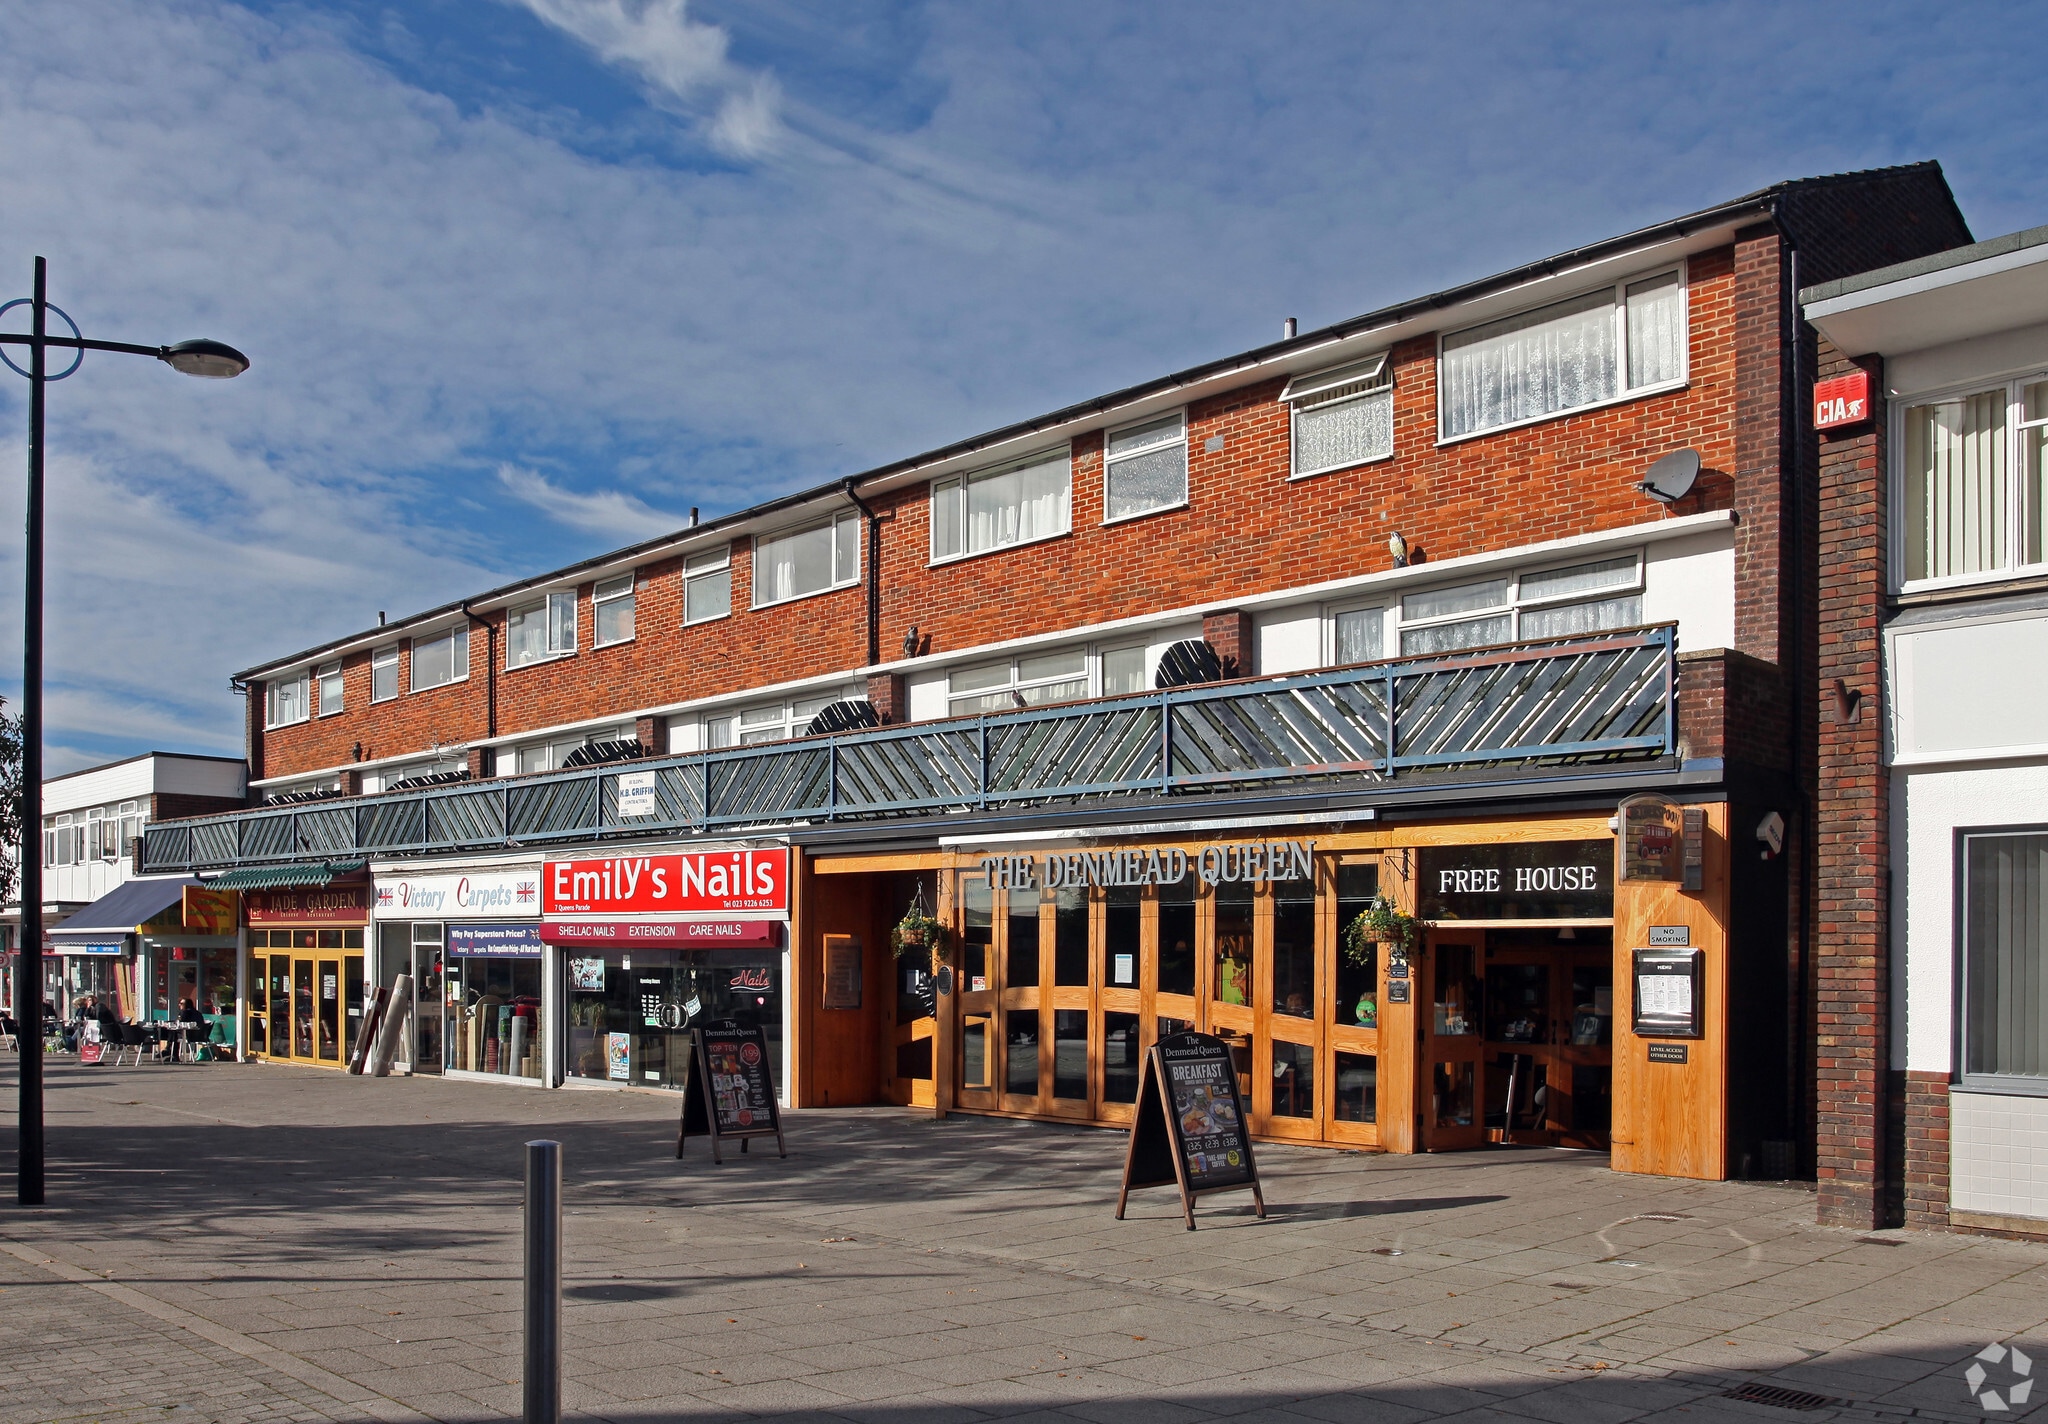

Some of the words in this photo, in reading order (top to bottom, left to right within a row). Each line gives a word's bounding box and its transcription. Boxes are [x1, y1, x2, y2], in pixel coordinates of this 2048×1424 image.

[1816, 397, 1847, 425] CIA
[631, 786, 654, 796] GRIFFIN
[980, 855, 1036, 890] THE
[1043, 847, 1187, 889] DENMEAD
[1197, 840, 1318, 887] QUEEN
[554, 858, 668, 901] Emily's
[681, 852, 775, 897] Nails
[1439, 868, 1500, 893] FREE
[1515, 866, 1597, 891] HOUSE
[398, 882, 446, 911] Victory
[457, 877, 512, 912] Carpets
[271, 895, 298, 913] JADE
[306, 891, 356, 913] GARDEN
[558, 904, 575, 912] Queens
[743, 899, 758, 907] 9226
[759, 899, 773, 907] 6253
[451, 930, 463, 939] Why
[463, 930, 474, 939] Pay
[474, 930, 505, 939] Superstore
[505, 930, 527, 938] Prices?
[558, 925, 592, 936] SHELLAC
[593, 925, 615, 937] NAILS
[629, 925, 675, 937] EXTENSION
[689, 925, 713, 936] CARE
[715, 924, 742, 936] NAILS
[729, 967, 770, 986] Nails
[705, 1029, 736, 1037] Denmead
[736, 1029, 757, 1037] Queen
[1185, 1036, 1199, 1045] The
[725, 1044, 738, 1052] TEN
[1165, 1046, 1199, 1057] Denmead
[1199, 1046, 1222, 1057] Queen
[1173, 1063, 1222, 1081] BREAKFAST
[1211, 1160, 1226, 1168] COFFEE
